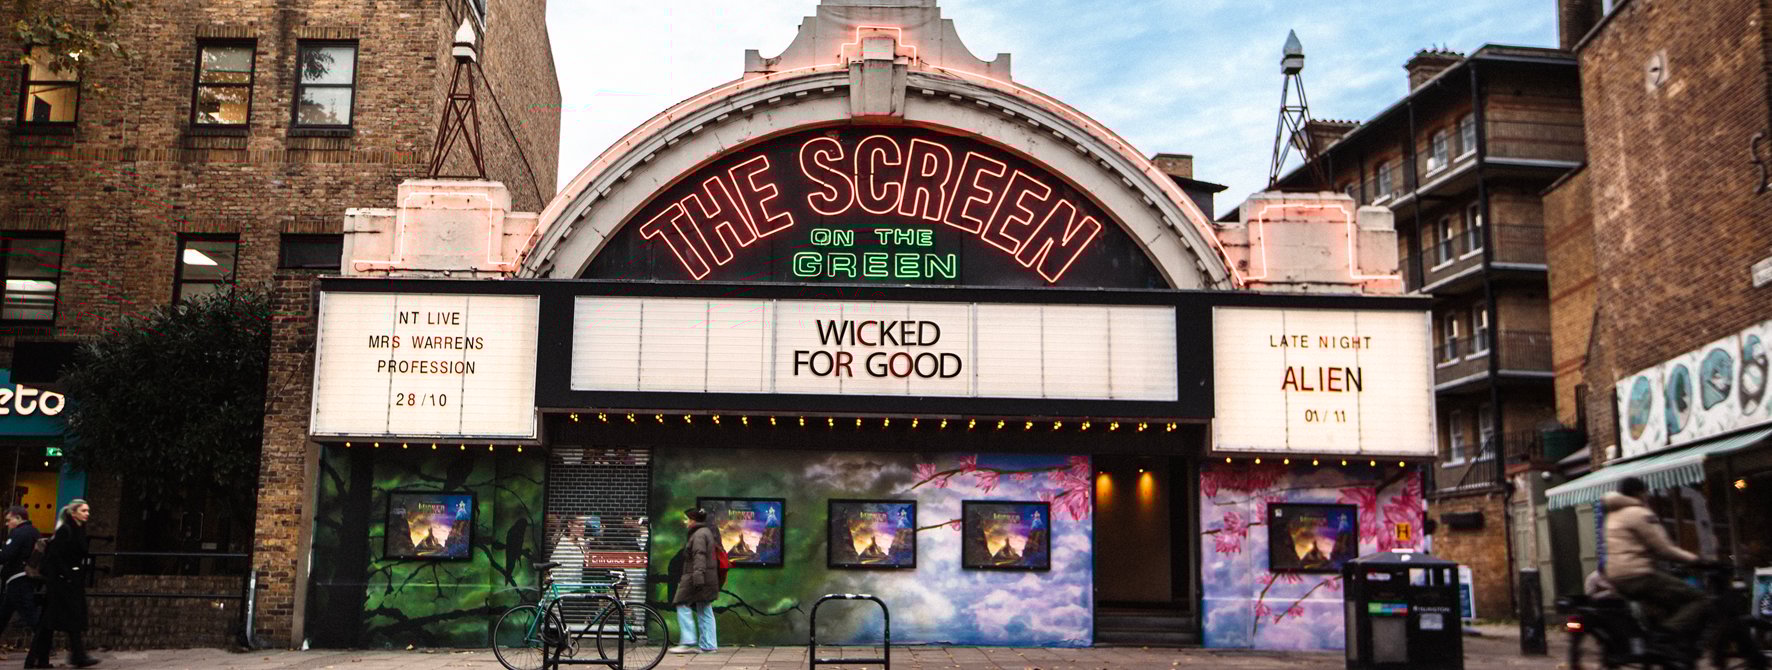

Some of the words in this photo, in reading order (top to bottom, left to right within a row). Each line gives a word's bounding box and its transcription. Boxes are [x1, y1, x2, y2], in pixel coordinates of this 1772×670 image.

[640, 155, 794, 280] THE
[799, 135, 1102, 283] SCREEN
[810, 228, 854, 246] ON
[874, 228, 934, 246] THE
[792, 251, 957, 279] GREEN
[399, 311, 420, 325] NT
[427, 312, 460, 325] LIVE
[816, 319, 941, 347] WICKED
[1269, 334, 1309, 348] LATE
[1319, 335, 1372, 349] NIGHT
[368, 335, 401, 349] MRS
[411, 335, 484, 350] WARRENS
[377, 359, 476, 375] PROFESSION
[793, 350, 854, 378] FOR
[865, 351, 963, 378] GOOD
[1281, 366, 1363, 393] ALIEN
[1396, 524, 1409, 538] H
[591, 555, 625, 564] Entrance
